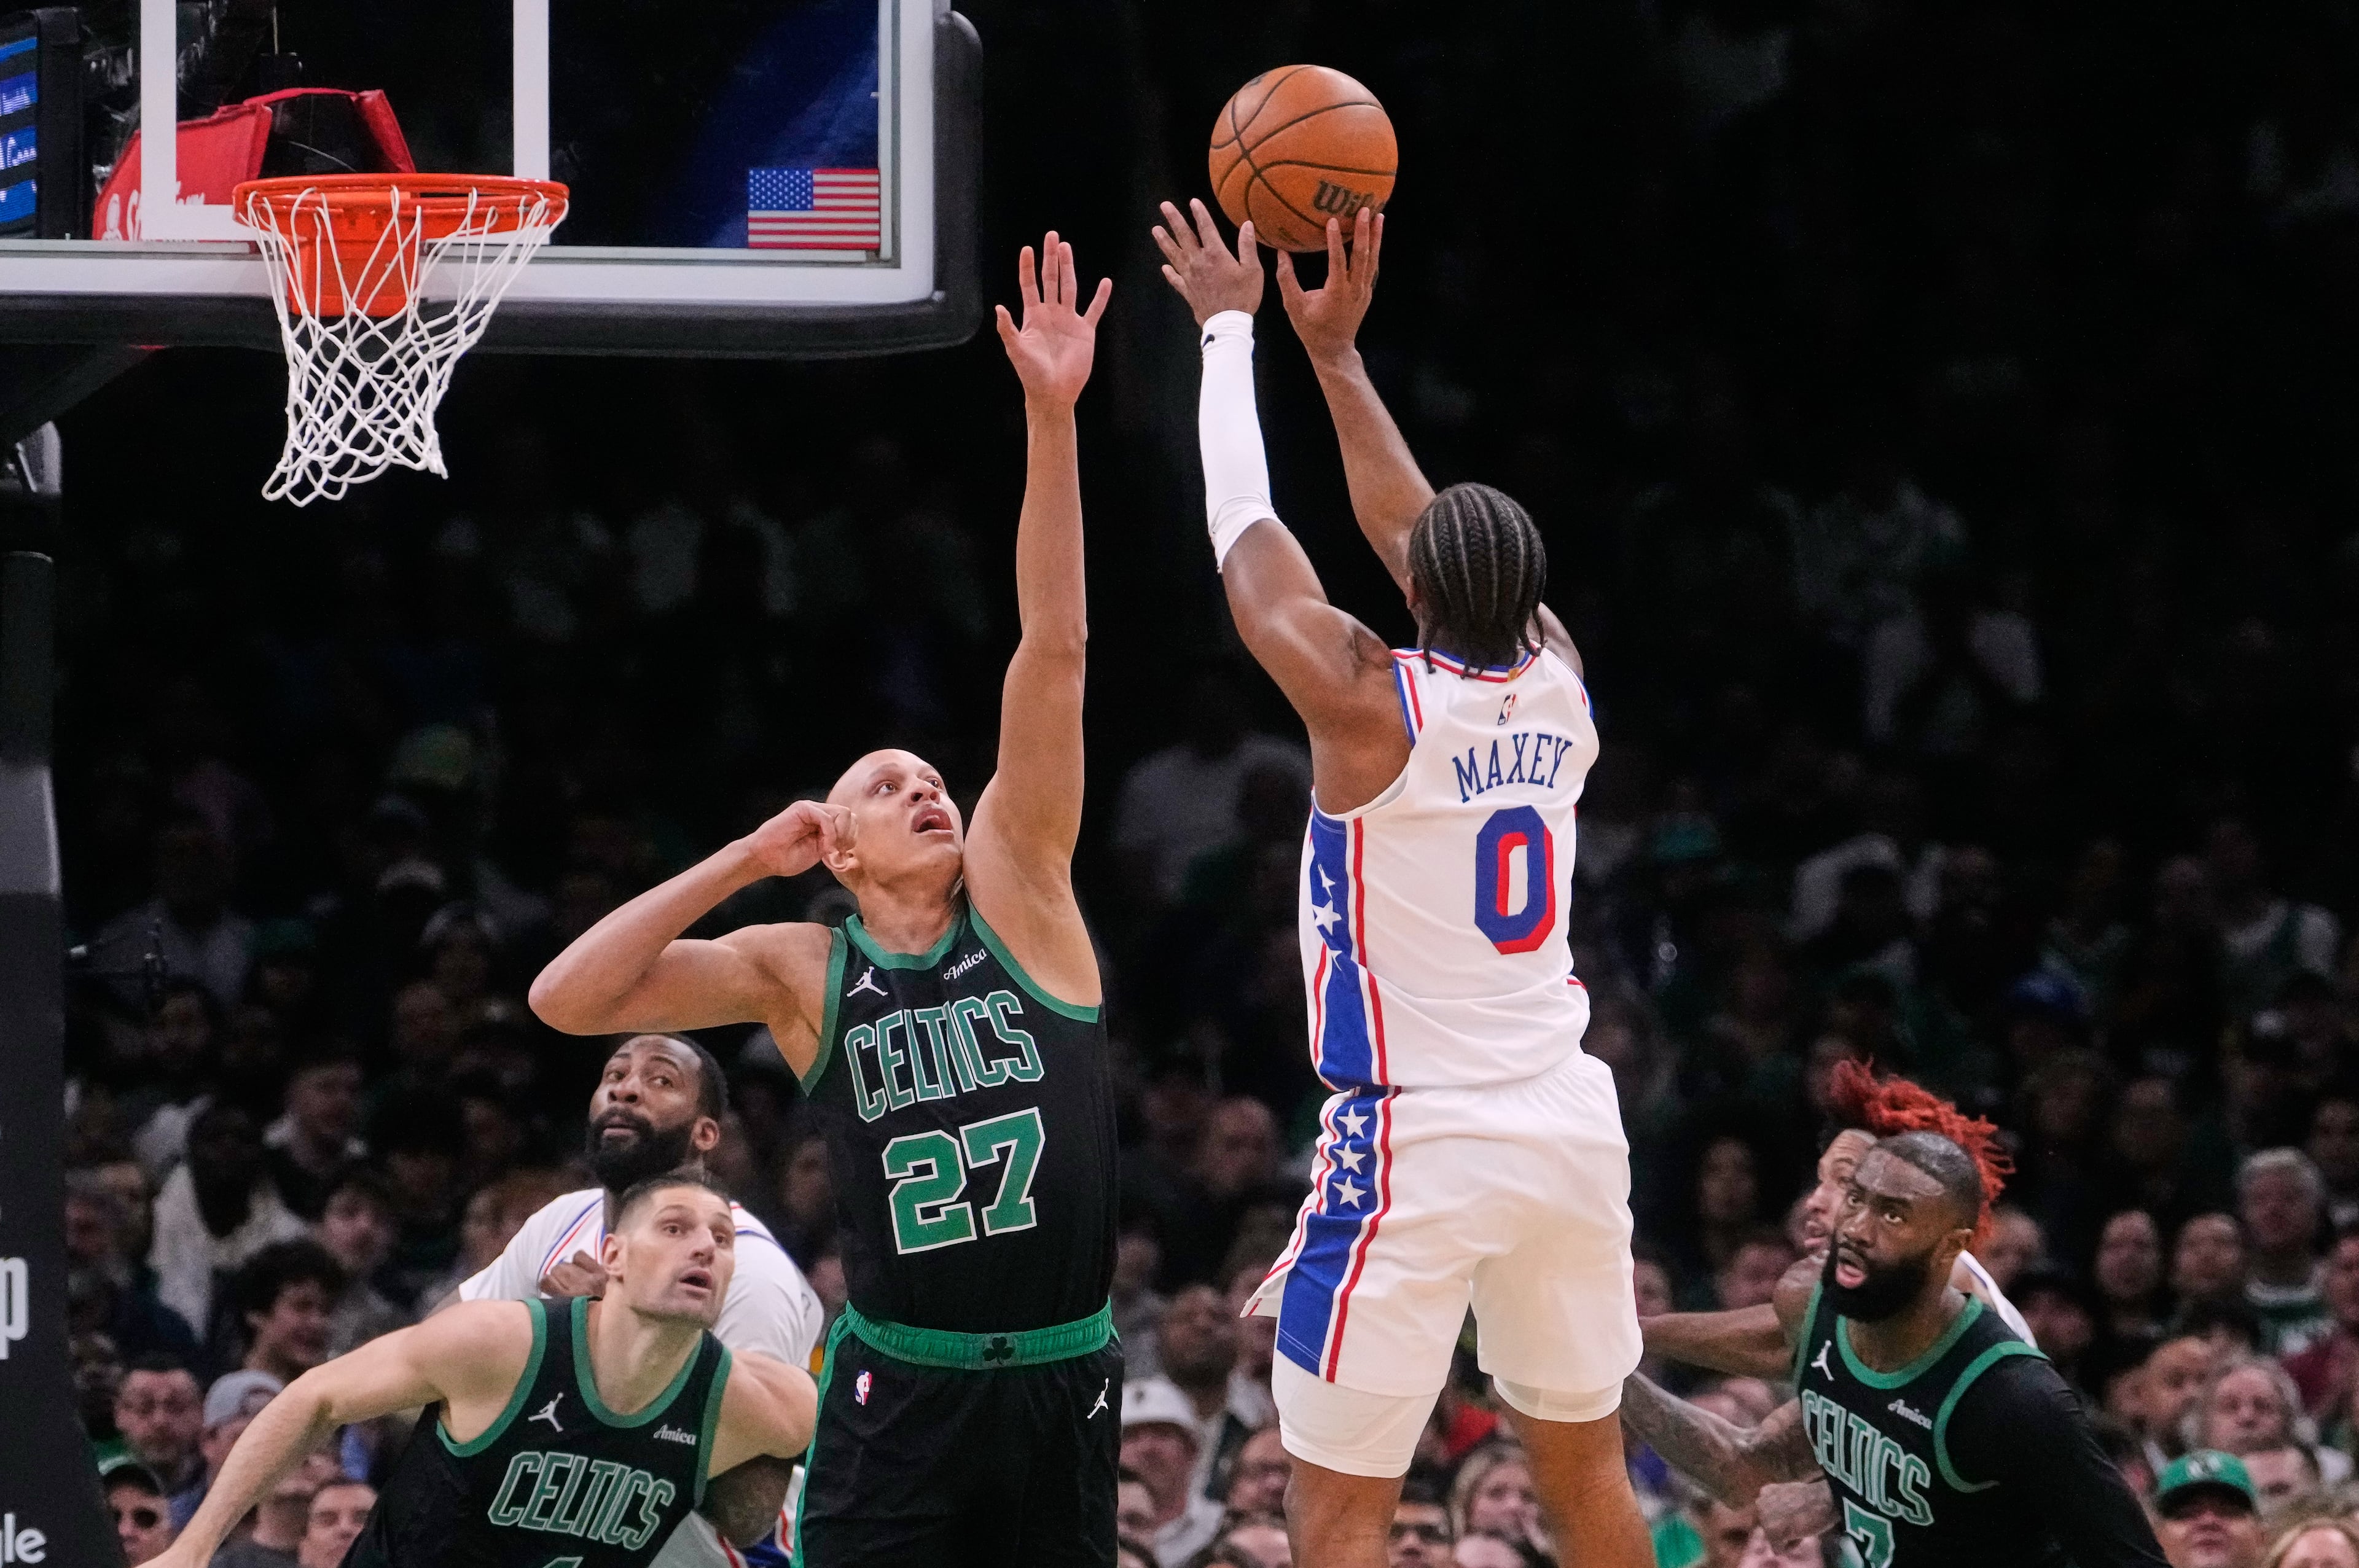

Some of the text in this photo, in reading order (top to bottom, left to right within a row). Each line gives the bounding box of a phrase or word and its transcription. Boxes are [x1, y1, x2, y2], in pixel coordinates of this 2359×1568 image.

[1313, 179, 1386, 218] Wil
[1452, 733, 1573, 803] MAXEY
[1474, 805, 1555, 954] 0
[943, 948, 987, 980] Amica
[844, 989, 1044, 1123] CELTICS
[882, 1106, 1046, 1255] 27
[653, 1424, 697, 1446] Amica
[1802, 1389, 1935, 1526] CELTICS
[487, 1451, 676, 1550] CELTICS
